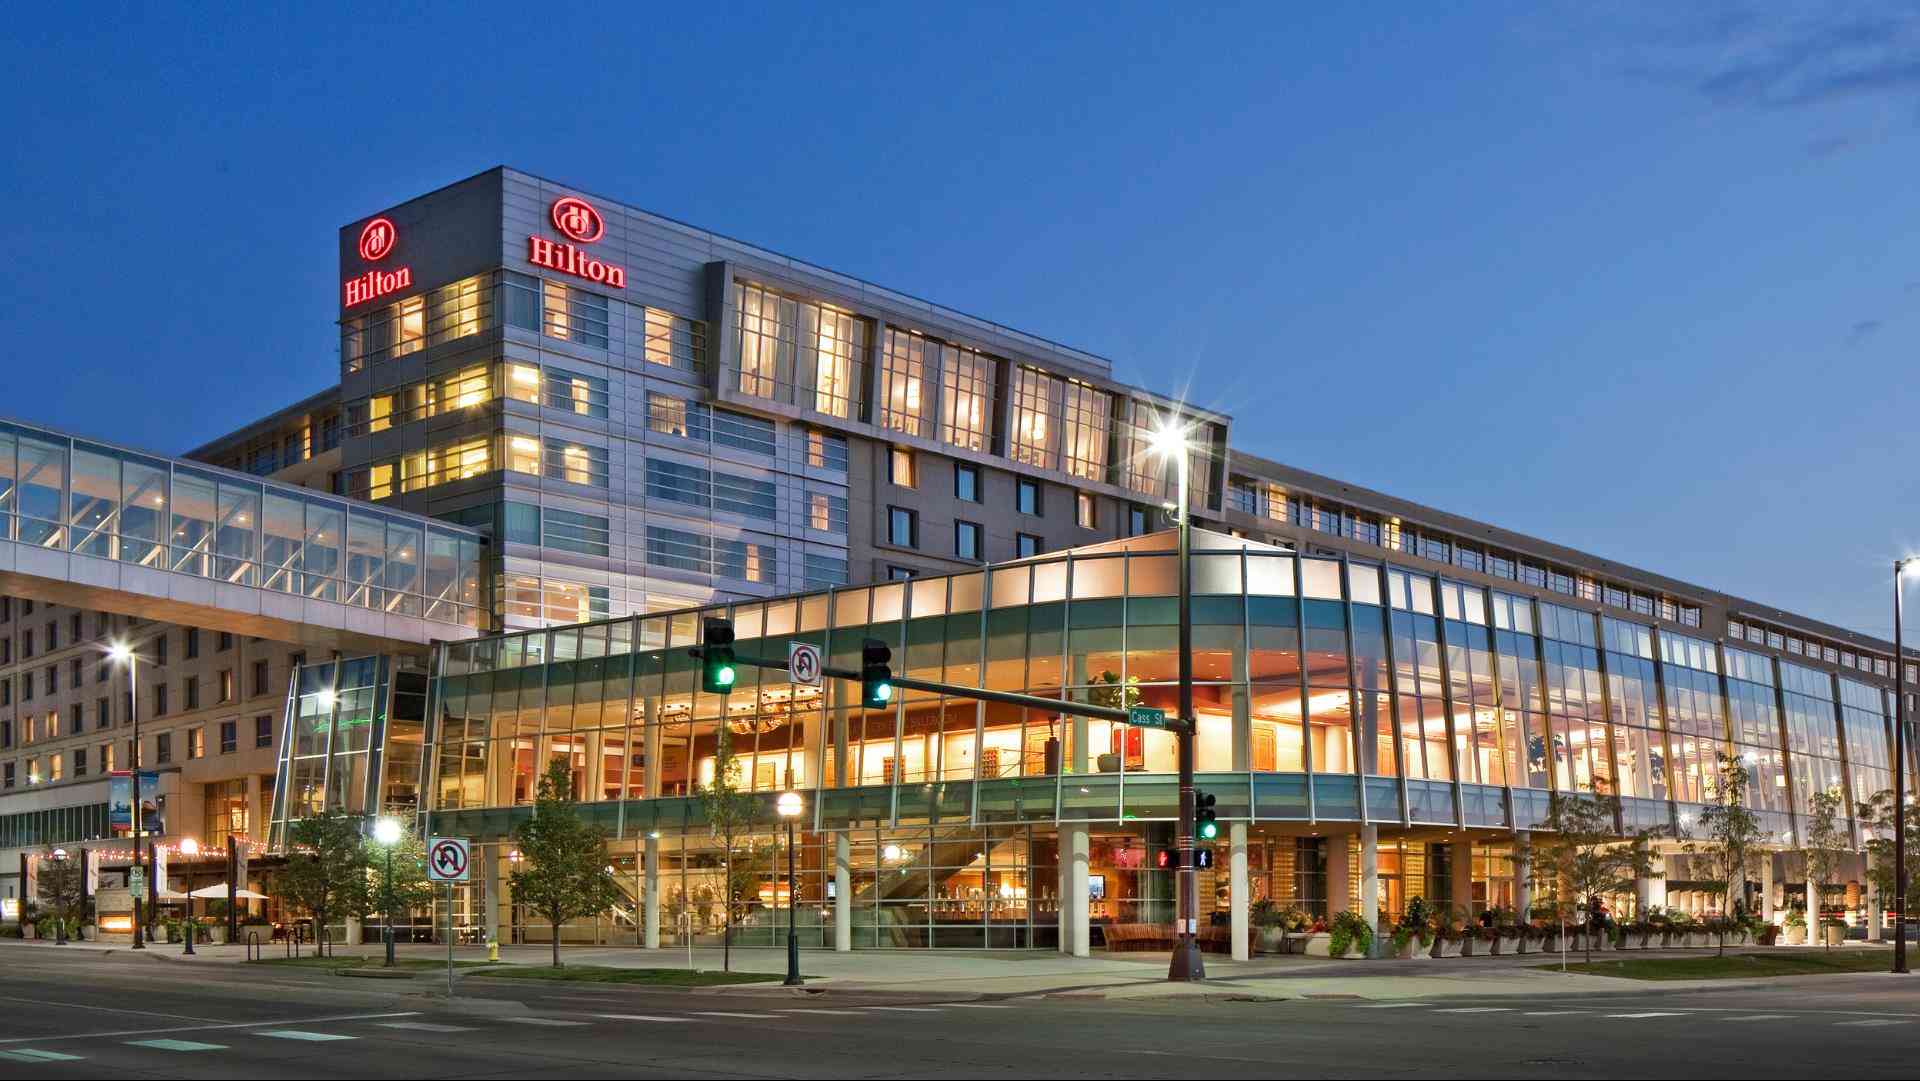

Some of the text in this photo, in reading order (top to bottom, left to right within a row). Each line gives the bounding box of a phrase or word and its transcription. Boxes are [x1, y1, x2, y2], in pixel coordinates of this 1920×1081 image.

[530, 236, 625, 288] Hilton
[345, 267, 411, 307] Hilton
[1131, 711, 1150, 724] Cass
